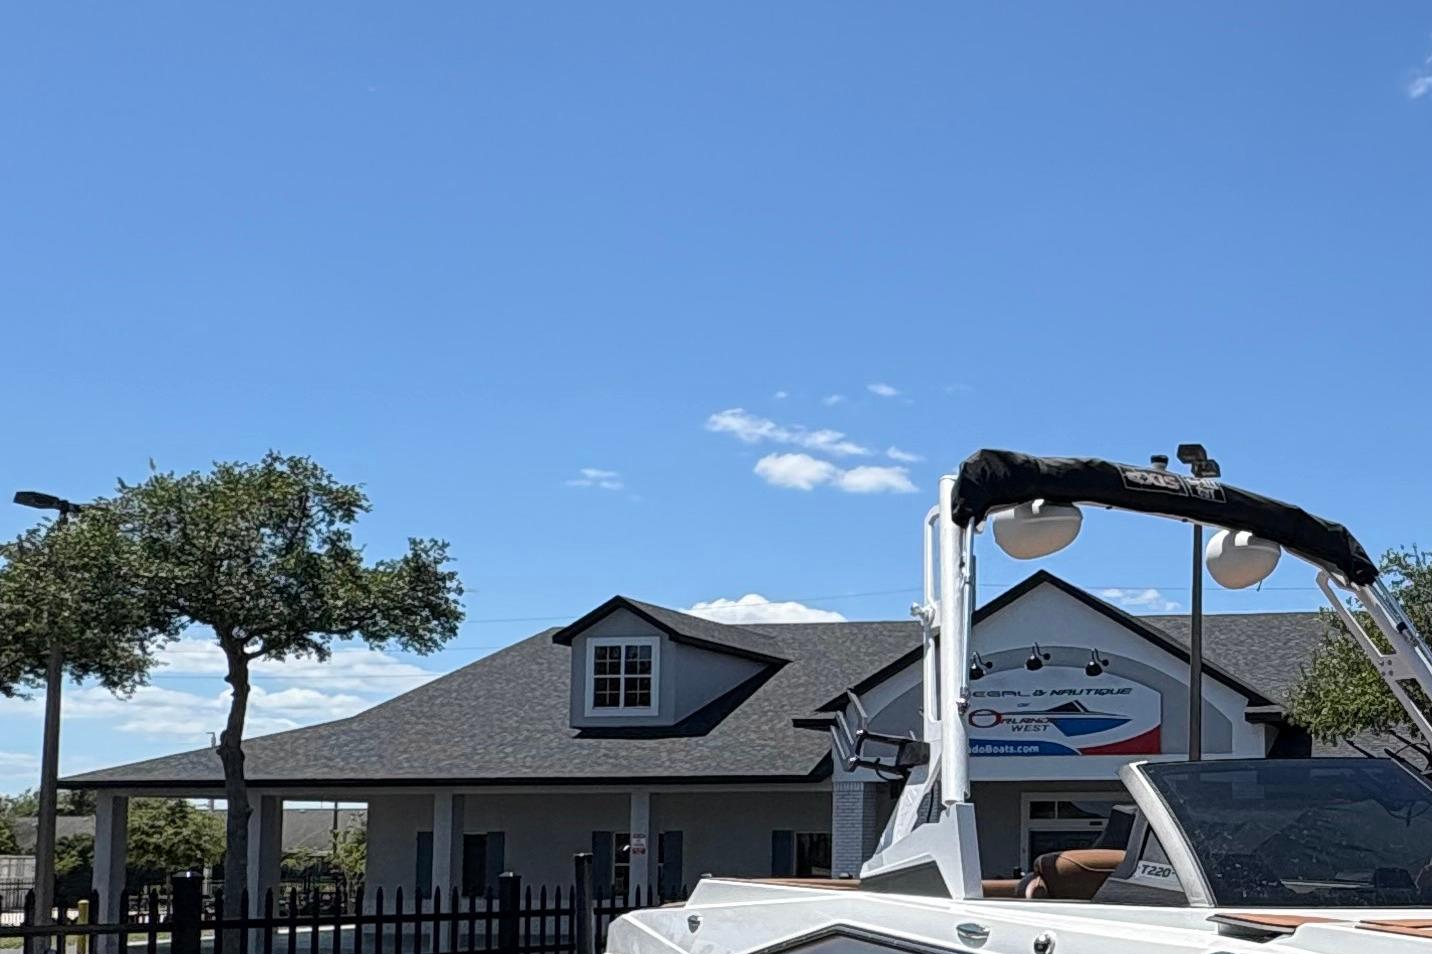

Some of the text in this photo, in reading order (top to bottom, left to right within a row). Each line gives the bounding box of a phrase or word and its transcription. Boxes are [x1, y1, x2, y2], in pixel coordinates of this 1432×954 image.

[972, 687, 1134, 698] EGAL & NAUTIQUE
[1011, 724, 1050, 733] WEST
[1141, 864, 1172, 878] T220
